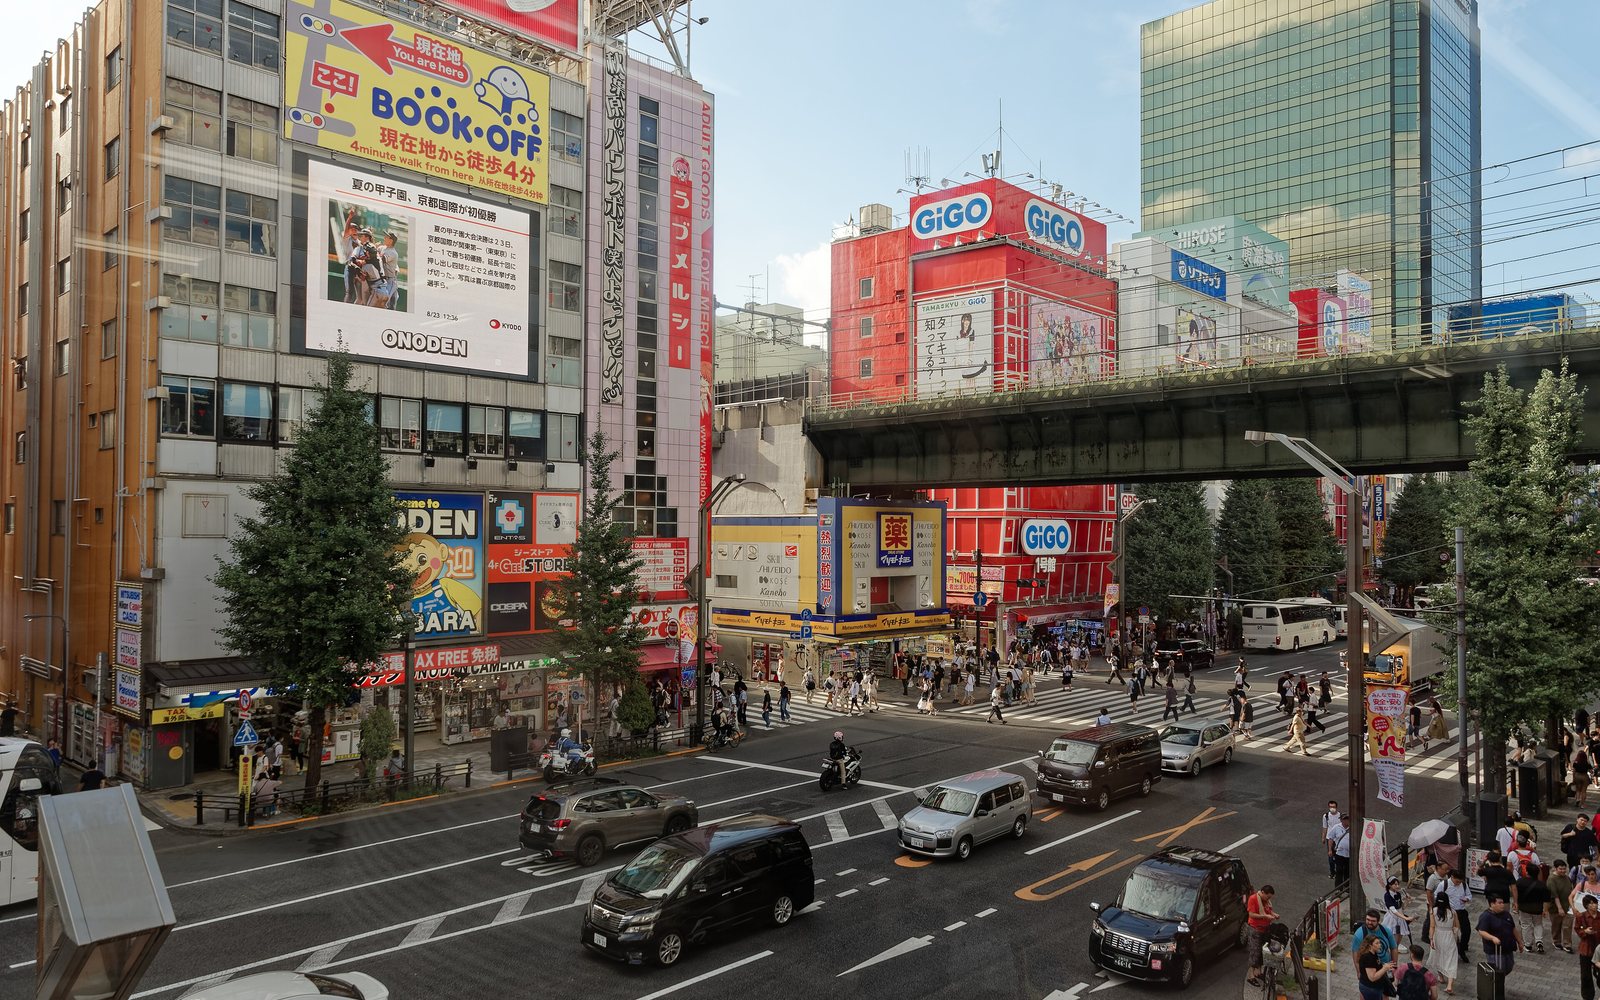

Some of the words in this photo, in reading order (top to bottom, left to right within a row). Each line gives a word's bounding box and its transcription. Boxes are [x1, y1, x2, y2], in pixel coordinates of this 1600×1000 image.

[393, 44, 414, 62] You
[417, 54, 437, 70] are
[438, 59, 464, 79] here
[415, 34, 462, 66] 現在地
[316, 65, 355, 92] ここ!
[701, 101, 711, 156] ADULT
[380, 126, 536, 185] 現在地から徒歩4分
[399, 153, 422, 169] walk
[425, 159, 450, 178] from
[452, 165, 474, 182] here
[352, 177, 497, 223] 夏の甲子園、京都国際が初優勝
[701, 158, 711, 220] GOODS
[915, 197, 988, 234] GiGO
[1027, 204, 1082, 249] GiGO
[1178, 225, 1226, 249] HIROSE
[672, 190, 691, 361] ラブメルシー
[700, 250, 711, 295] LOVE
[502, 323, 522, 331] KYODO
[700, 297, 709, 349] MERCI
[381, 328, 468, 357] ONODEN
[884, 516, 908, 548] 薬
[1025, 524, 1069, 549] GiGO
[514, 548, 554, 557] ジーストア
[757, 565, 792, 574] SHISEIDO
[759, 588, 787, 597] Kanebo
[803, 627, 810, 637] P
[120, 645, 138, 656] HITACHI
[120, 654, 138, 666] TOSHIBA
[414, 650, 435, 668] AX
[437, 649, 469, 667] FREE
[471, 646, 499, 663] 免税
[119, 684, 138, 698] Panasonic
[121, 673, 137, 686] SONY
[119, 696, 138, 708] SHARP
[168, 708, 185, 716] TAX
